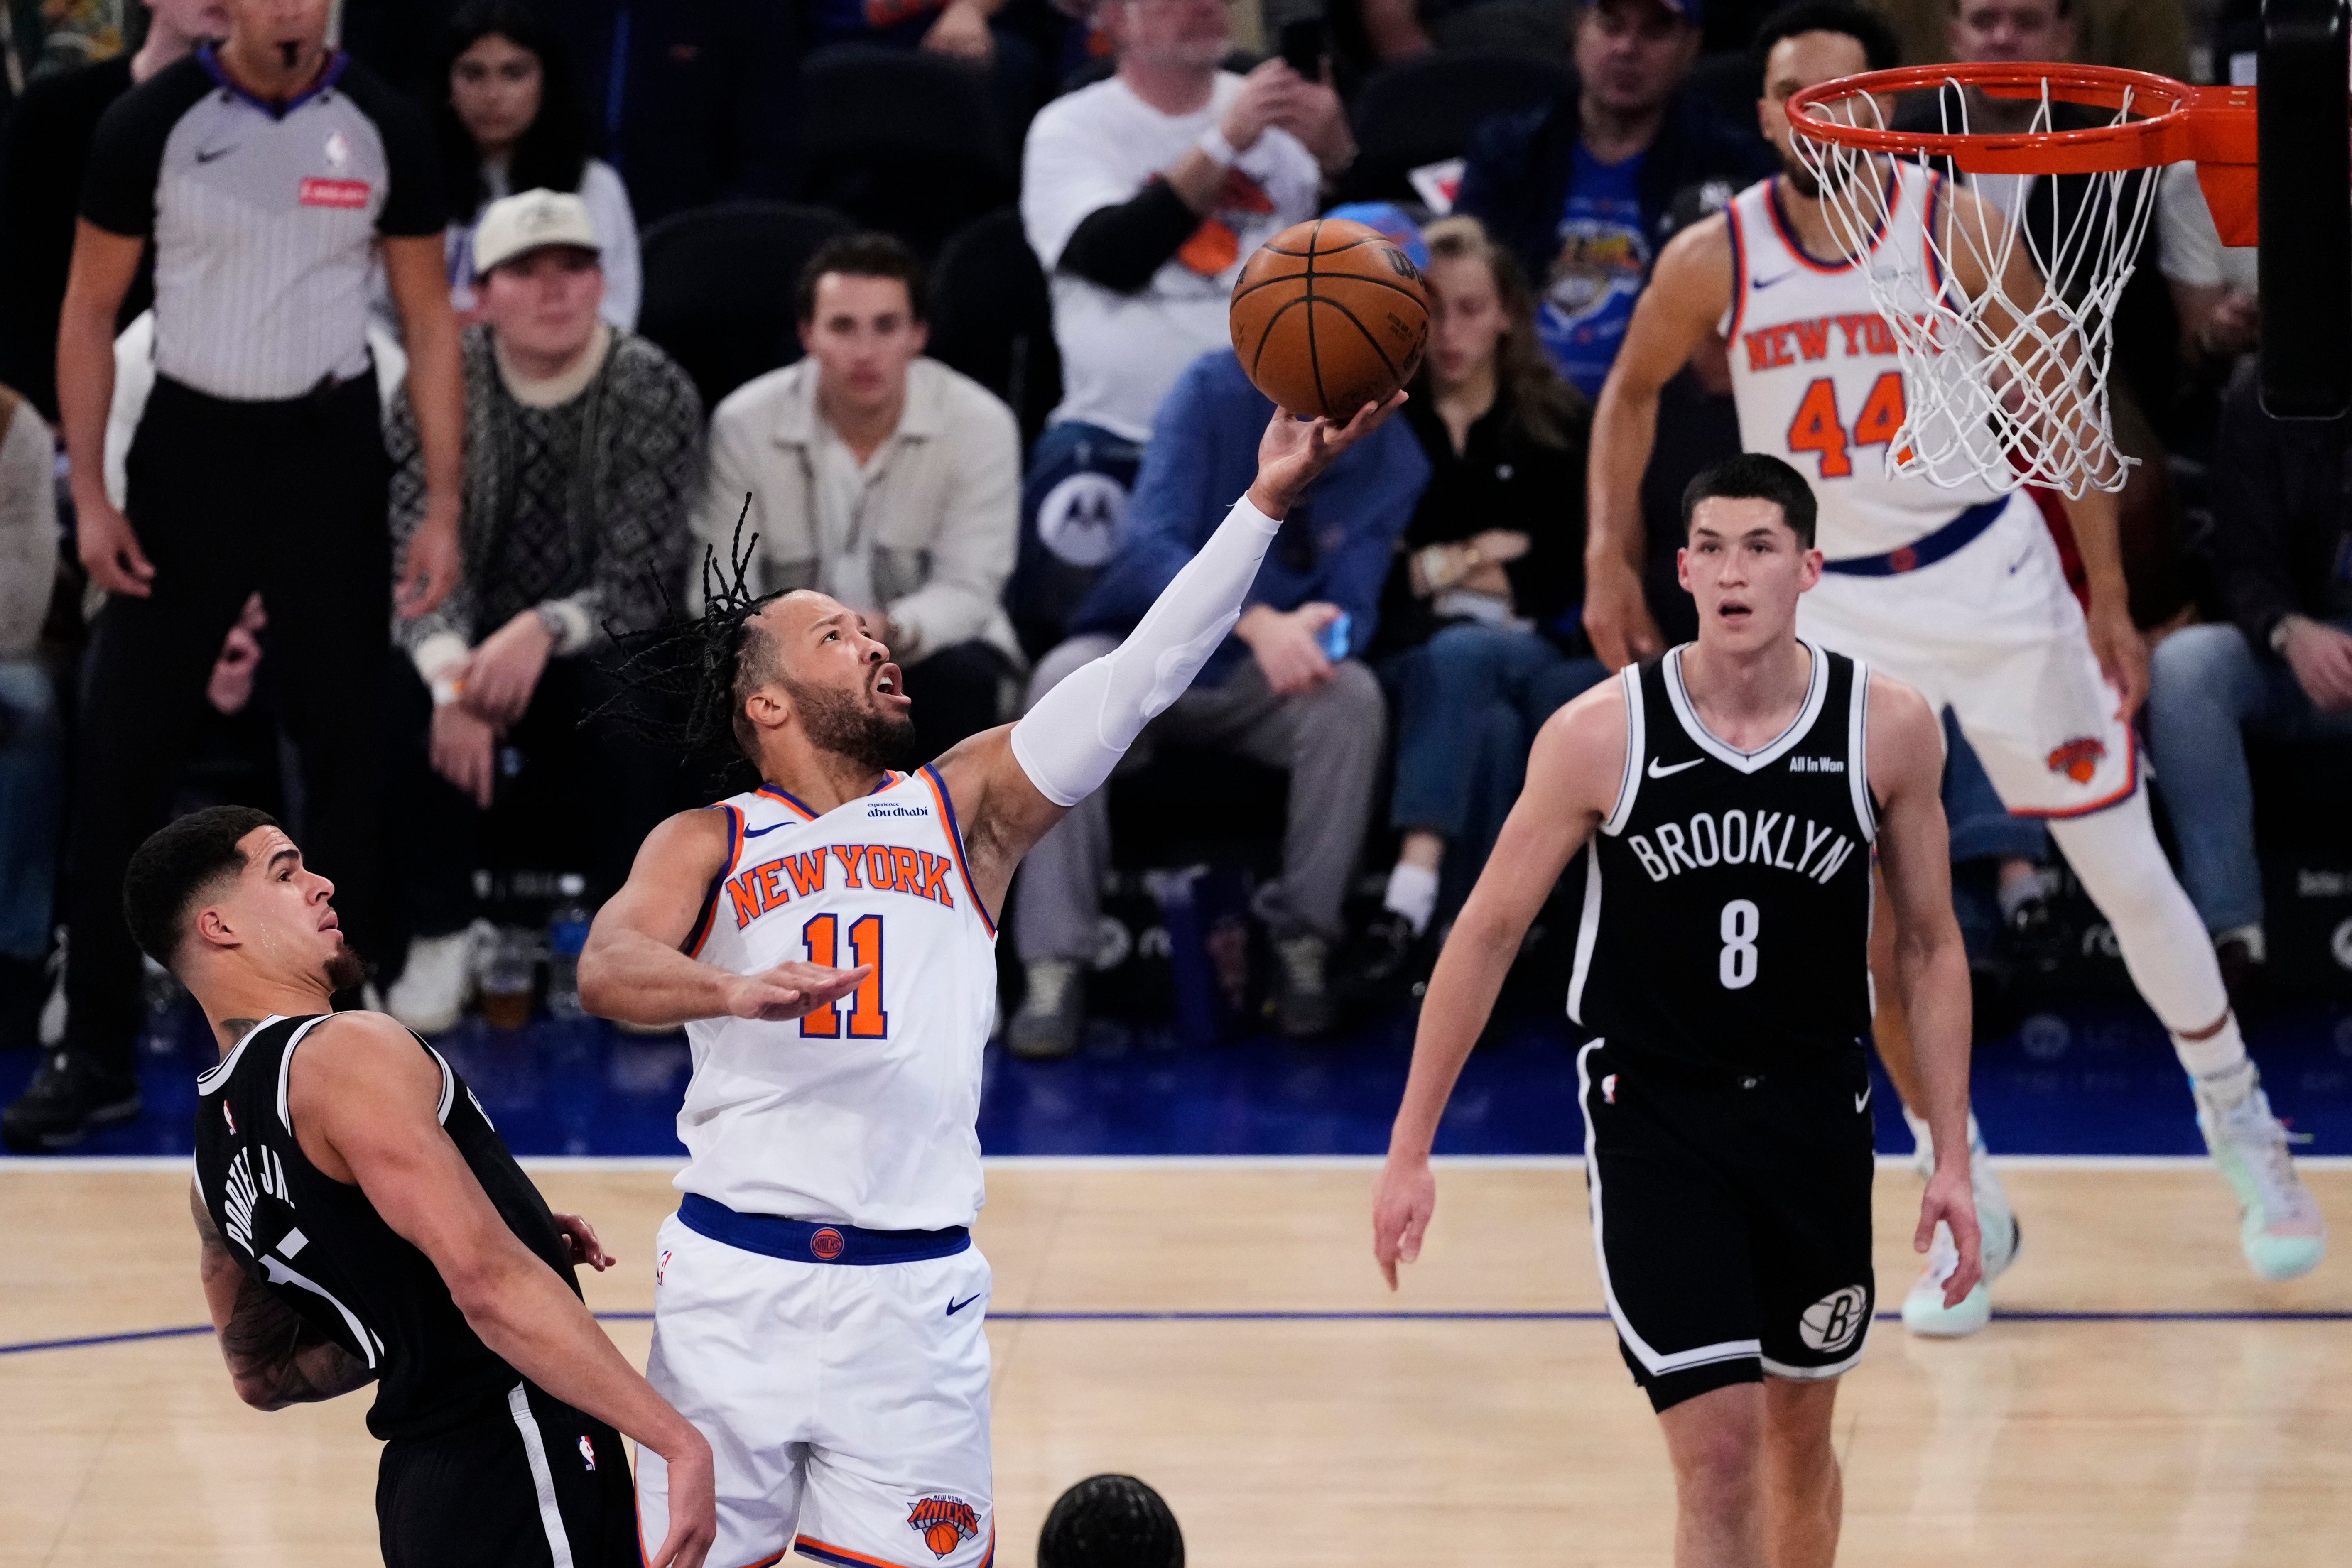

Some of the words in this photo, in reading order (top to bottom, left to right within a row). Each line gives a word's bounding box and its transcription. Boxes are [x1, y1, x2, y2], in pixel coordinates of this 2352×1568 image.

[1744, 317, 1830, 372] NEW
[1788, 371, 1915, 481] 44
[1789, 756, 1805, 772] All
[1807, 756, 1818, 772] In
[1819, 756, 1844, 772] Won
[868, 808, 891, 817] abu
[1628, 809, 1855, 884] BROOKLYN
[725, 846, 828, 931] NEW
[831, 844, 955, 911] YORK
[799, 912, 888, 1040] 11
[1719, 898, 1760, 990] 8
[225, 1146, 258, 1258] PORTE
[907, 1497, 979, 1536] KNICKS
